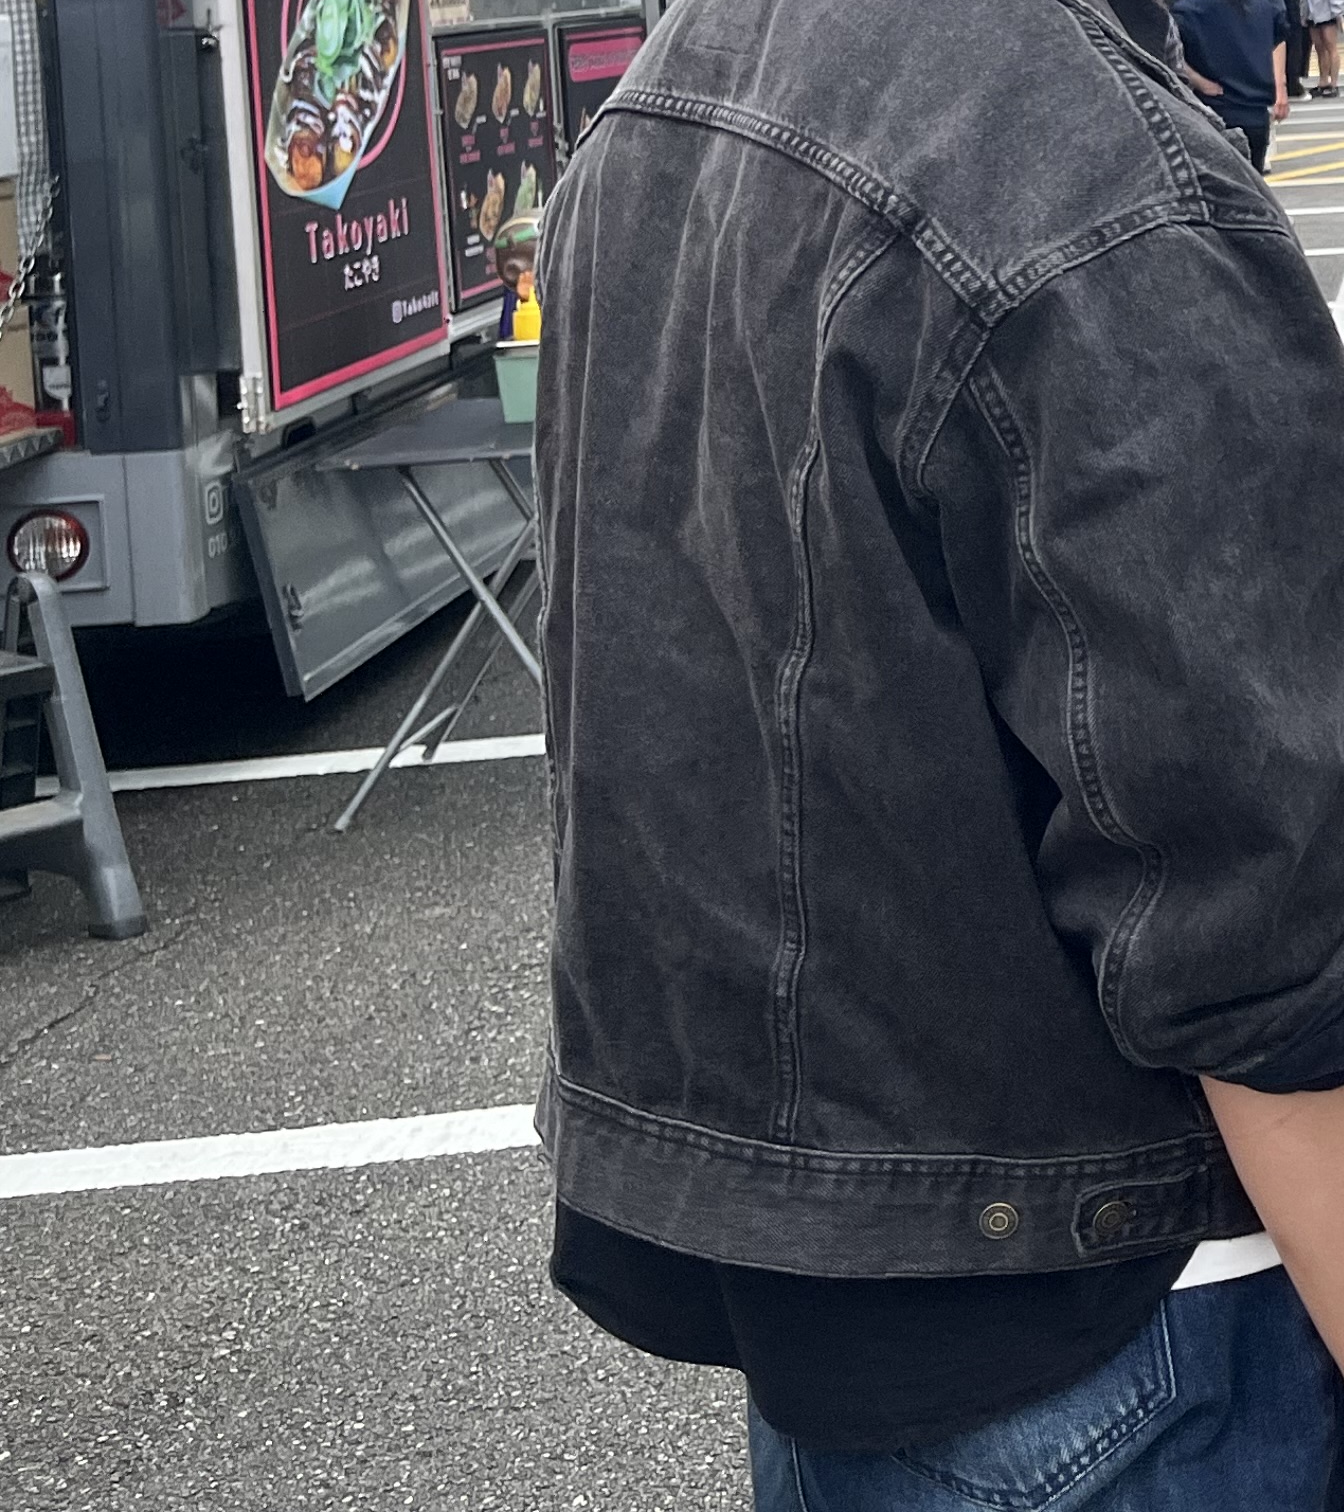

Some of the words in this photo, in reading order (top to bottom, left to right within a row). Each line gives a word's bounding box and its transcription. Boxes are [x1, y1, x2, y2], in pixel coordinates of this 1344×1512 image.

[304, 196, 409, 264] Takoyaki
[343, 254, 381, 291] たこやき
